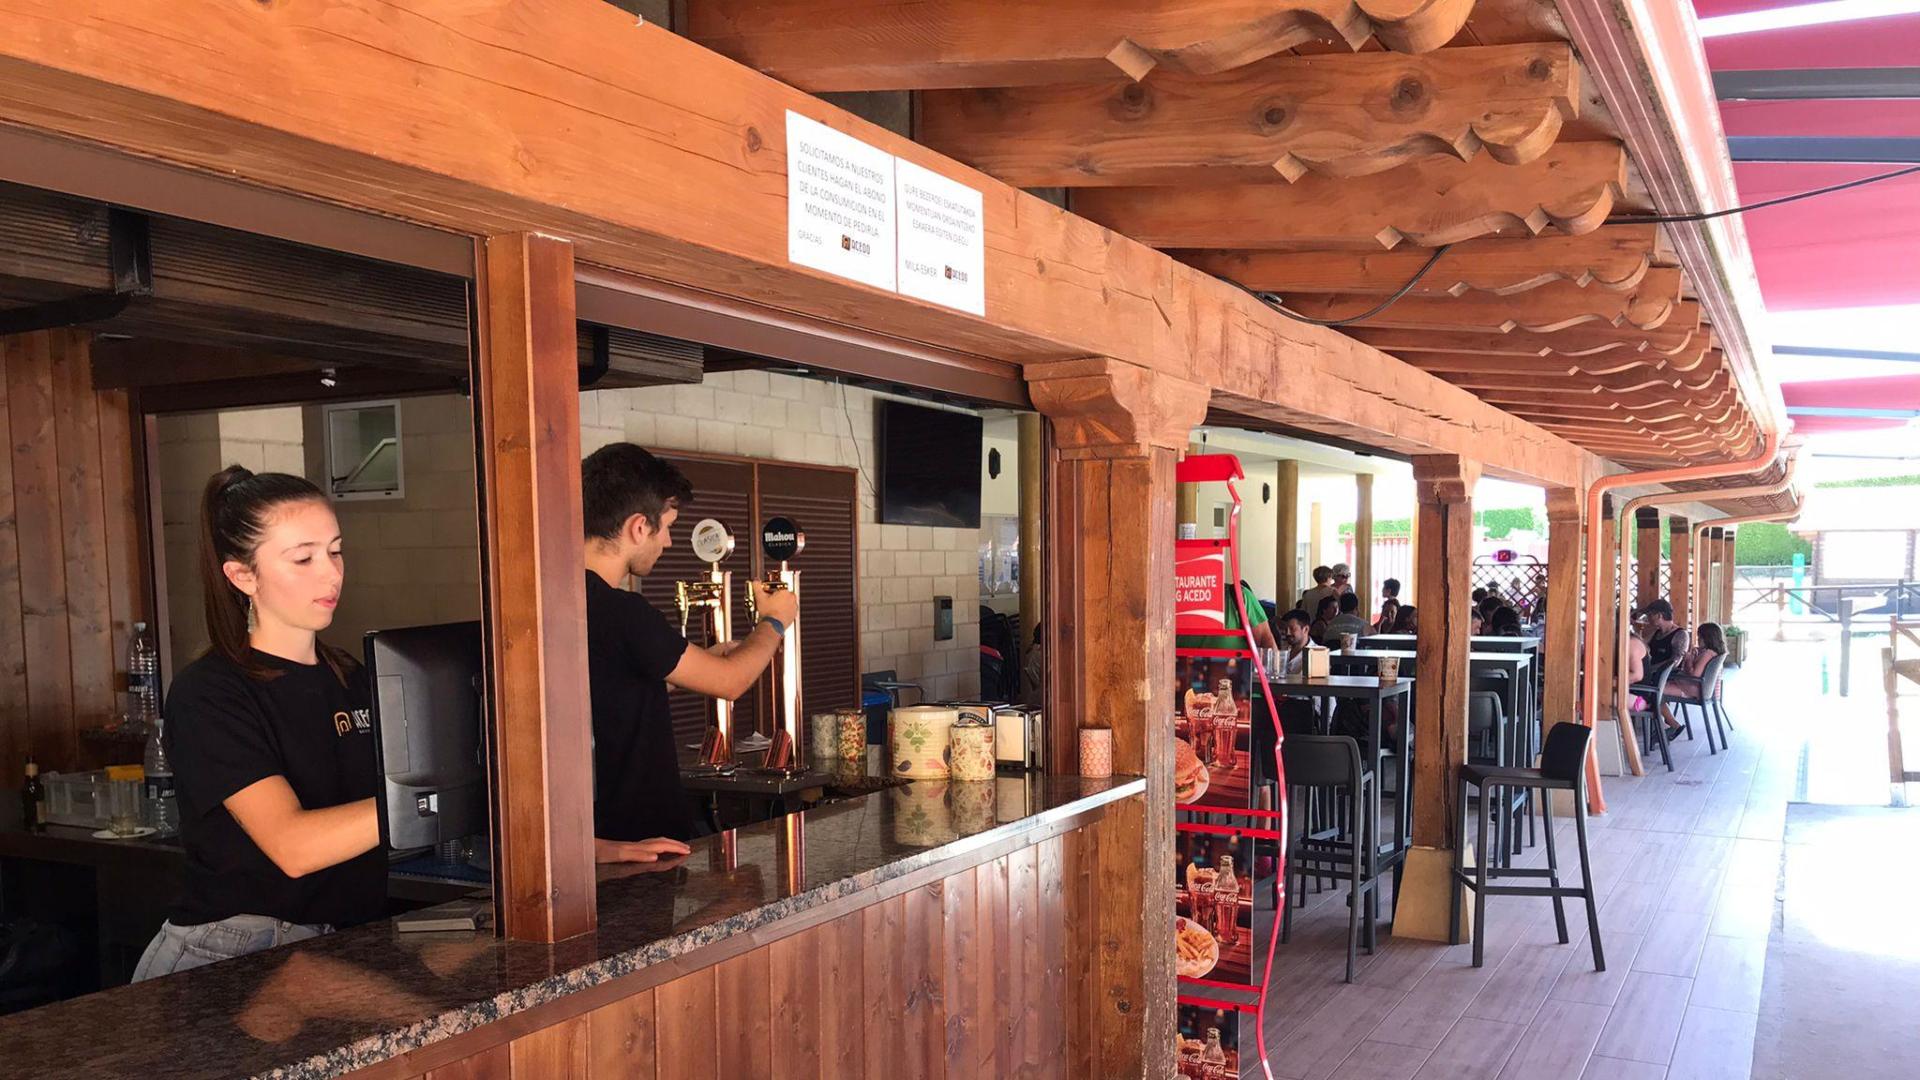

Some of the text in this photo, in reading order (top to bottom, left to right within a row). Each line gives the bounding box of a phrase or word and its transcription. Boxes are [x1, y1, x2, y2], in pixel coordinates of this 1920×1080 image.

[799, 141, 884, 184] SOLICITAMOS A NUESTROS
[798, 160, 886, 204] CLIENTES HAGAN EL ABONO
[800, 181, 808, 193] DE
[810, 185, 818, 197] LA
[868, 206, 876, 218] EN
[878, 210, 884, 222] EL
[805, 202, 842, 224] MOMENTO
[844, 216, 851, 227] DE
[764, 532, 794, 542] Mahou
[1183, 589, 1212, 602] ACEDO
